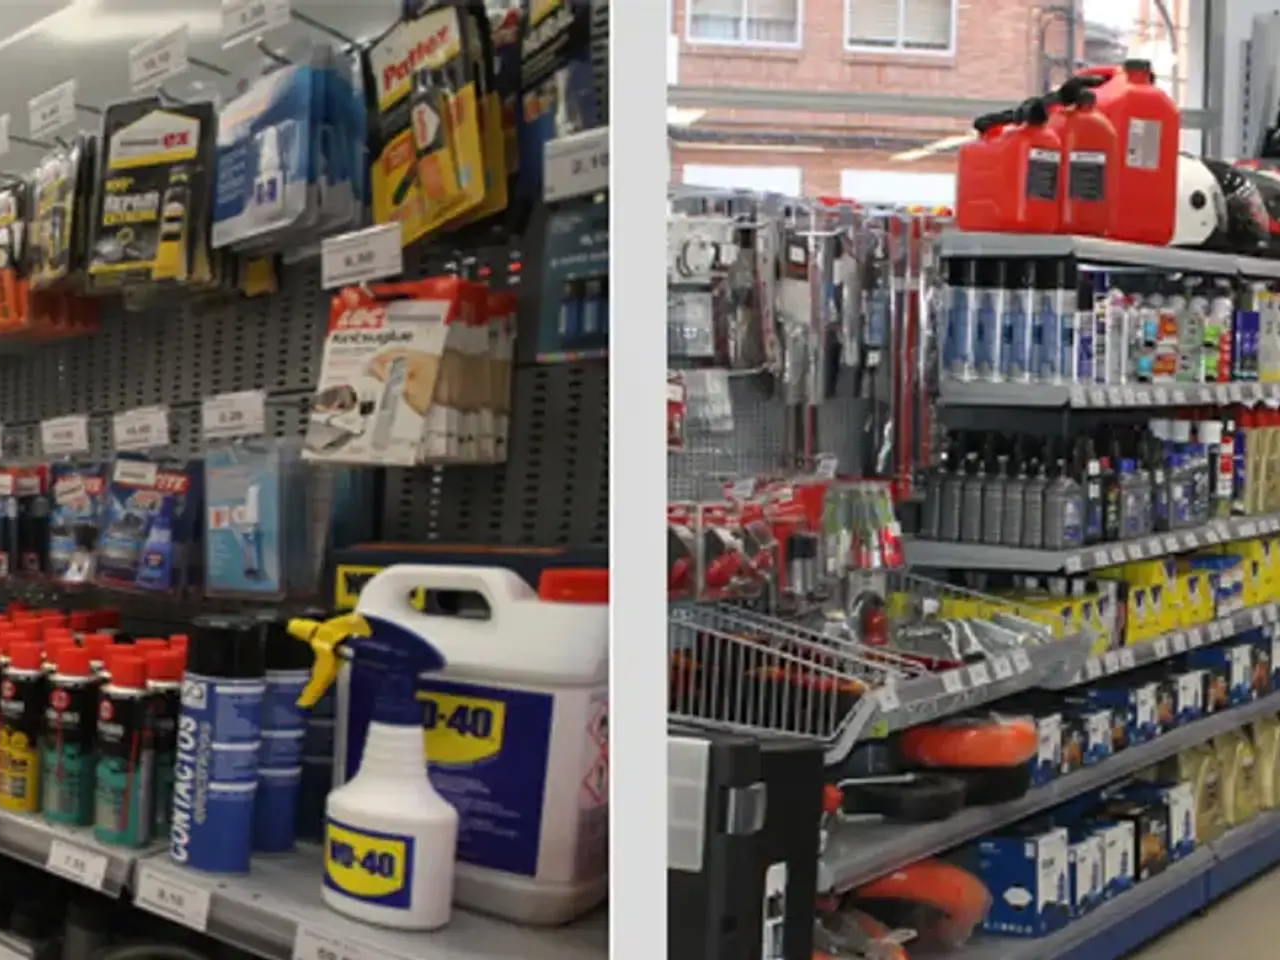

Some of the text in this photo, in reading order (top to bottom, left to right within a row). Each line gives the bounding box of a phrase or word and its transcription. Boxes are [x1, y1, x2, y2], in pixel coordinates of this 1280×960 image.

[423, 701, 494, 739] D-40
[171, 714, 198, 863] CONTACTOS
[330, 838, 396, 879] WD-40
